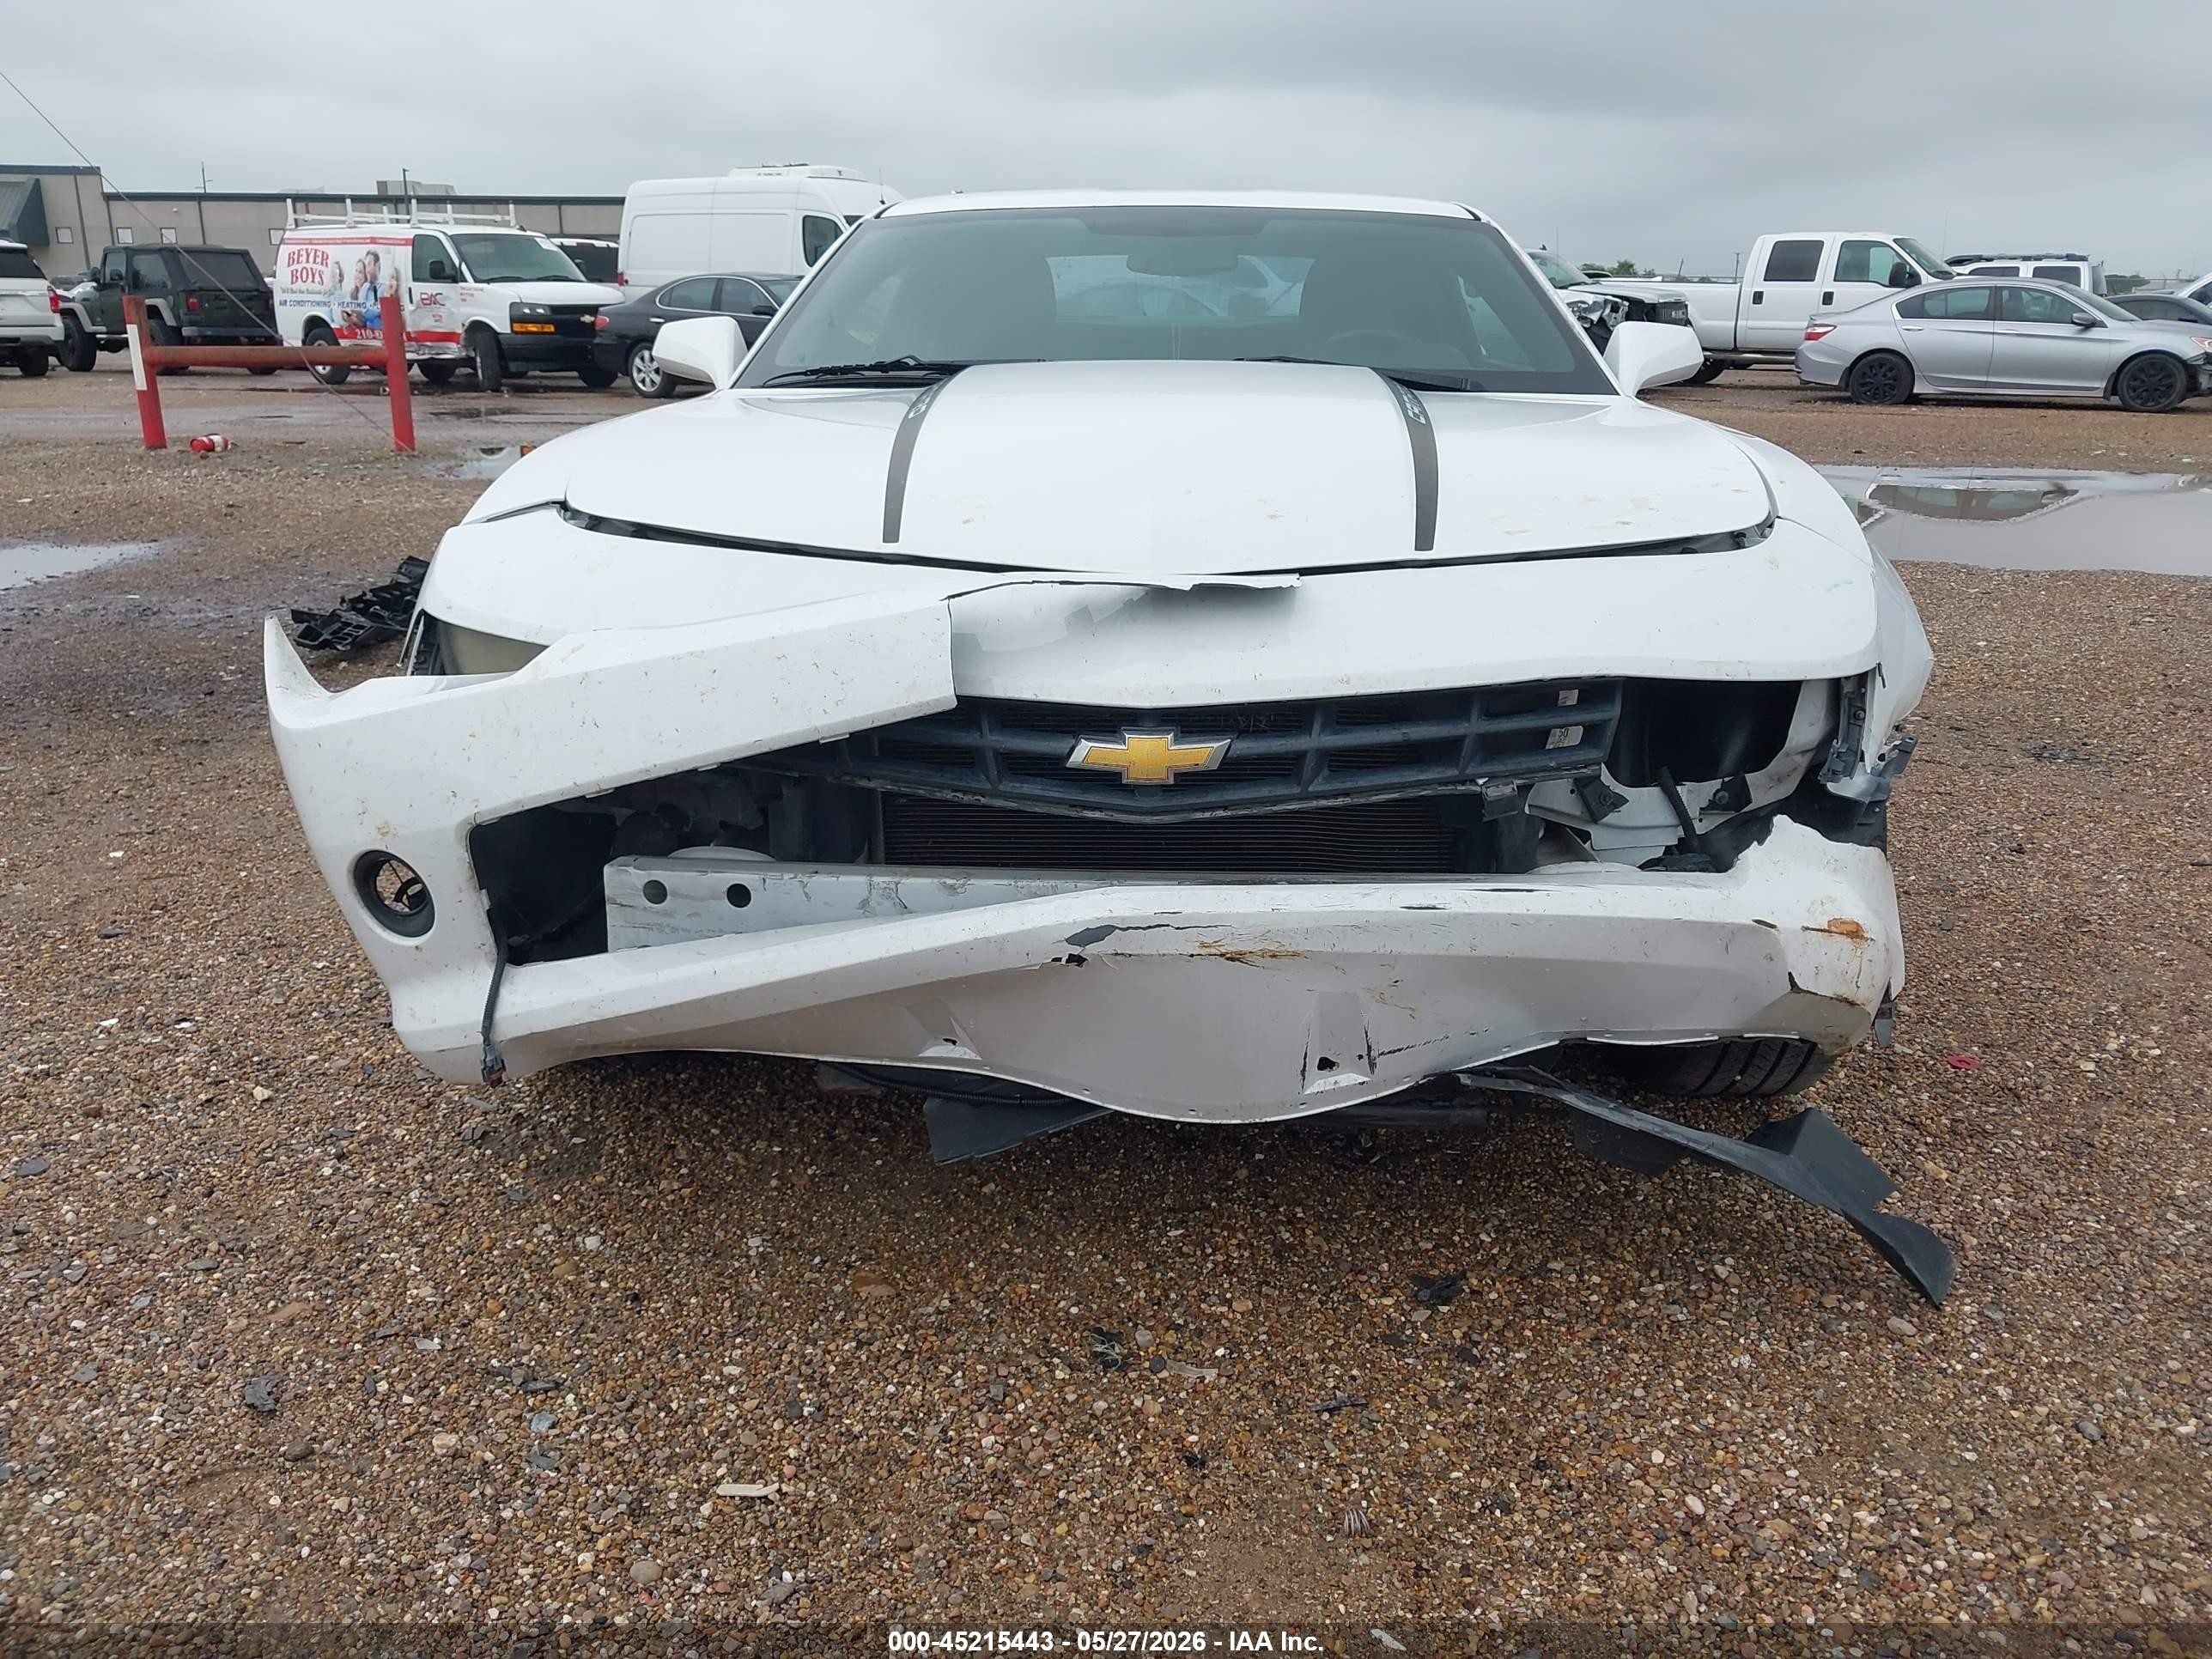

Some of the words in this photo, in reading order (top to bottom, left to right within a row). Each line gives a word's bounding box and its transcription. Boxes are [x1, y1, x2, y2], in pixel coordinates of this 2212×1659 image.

[287, 247, 330, 268] BEYER
[290, 266, 325, 286] BOYS
[279, 299, 288, 307] AIR
[289, 299, 331, 309] CONDITIONING
[338, 301, 367, 310] HEATING
